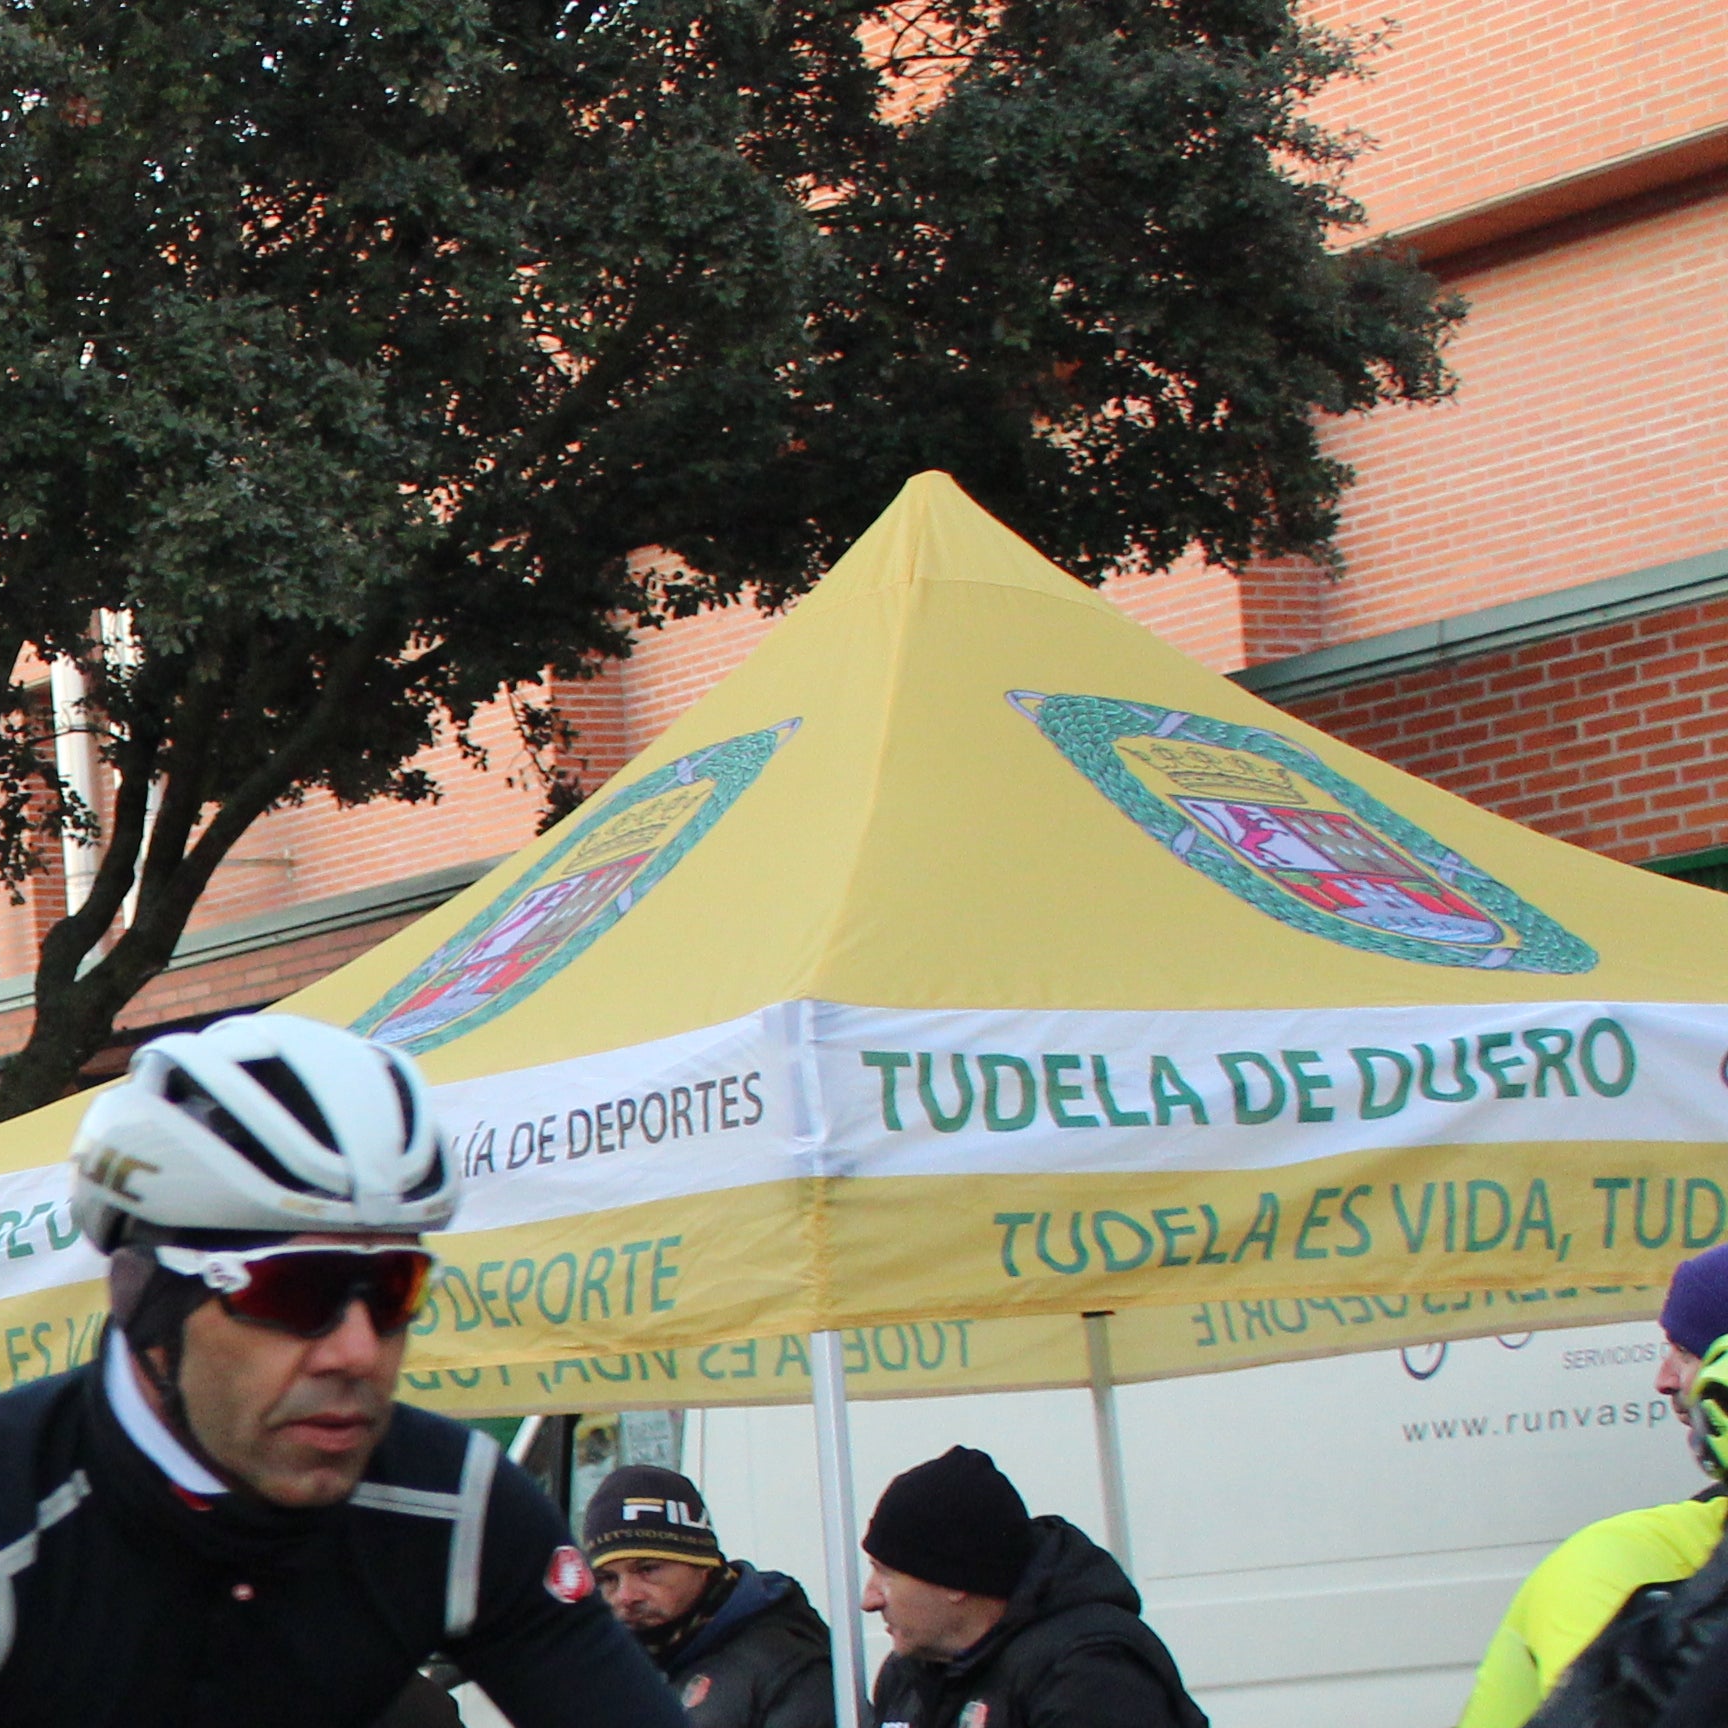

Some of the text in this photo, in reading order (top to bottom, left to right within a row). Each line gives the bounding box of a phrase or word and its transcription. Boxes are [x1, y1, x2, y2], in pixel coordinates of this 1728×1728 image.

[506, 1115, 556, 1170] DE
[566, 1071, 764, 1160] DEPORTES
[861, 1049, 1210, 1133] TUDELA
[1217, 1050, 1334, 1125] DE
[1349, 1017, 1636, 1121] DUERO
[994, 1176, 1728, 1278] TUDELA ES VIDA, TUD
[443, 1234, 683, 1333] DEPORTE
[5, 1321, 52, 1387] ES
[1562, 1343, 1657, 1371] SERVICIOS
[1402, 1398, 1668, 1444] www.runvasp
